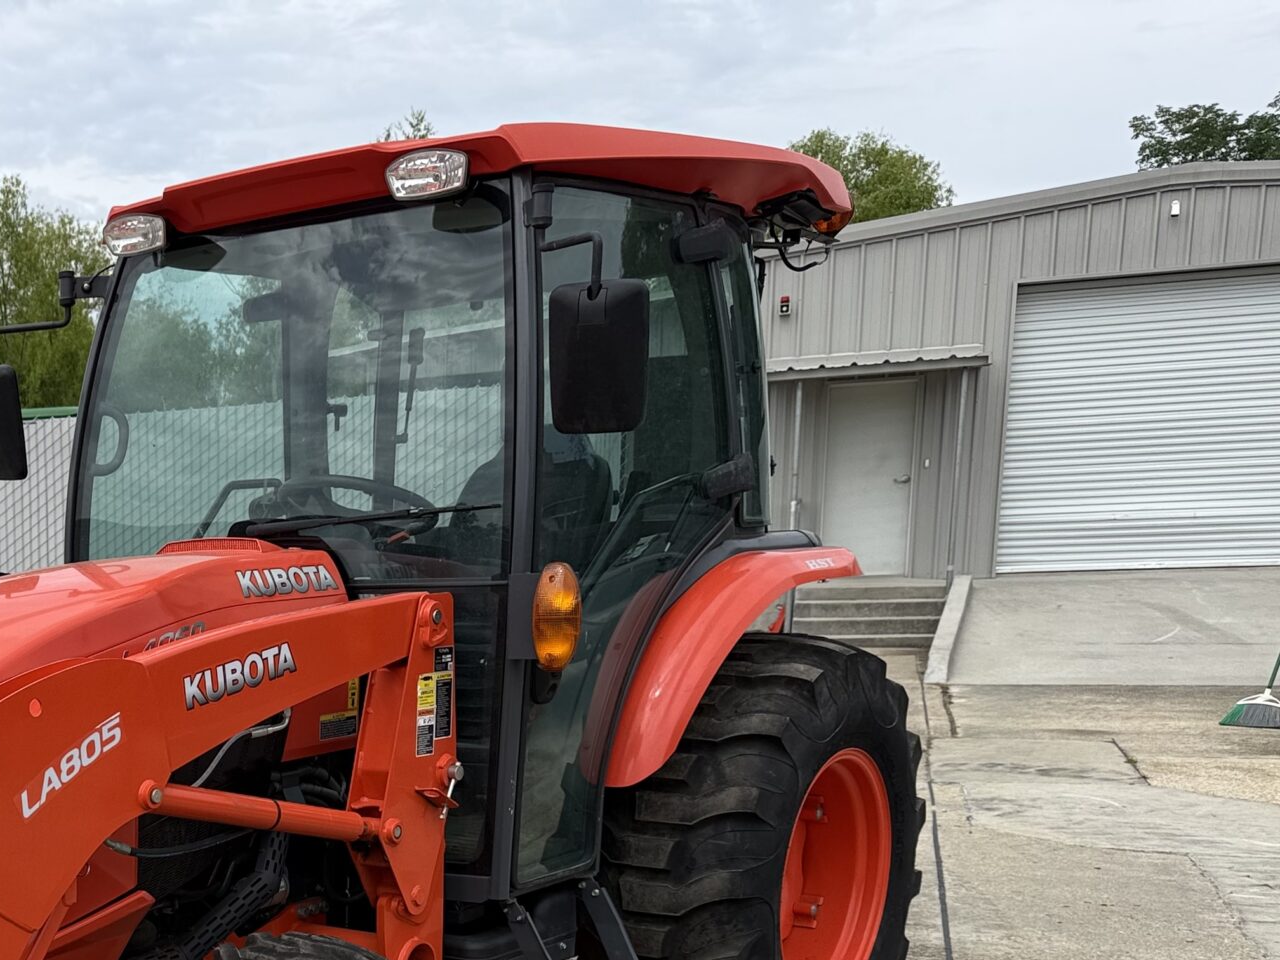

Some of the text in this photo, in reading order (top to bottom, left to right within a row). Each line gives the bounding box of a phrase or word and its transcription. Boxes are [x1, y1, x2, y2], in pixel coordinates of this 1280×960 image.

[235, 564, 339, 598] KUBOTA
[183, 641, 297, 711] KUBOTA
[21, 715, 122, 819] LA805
